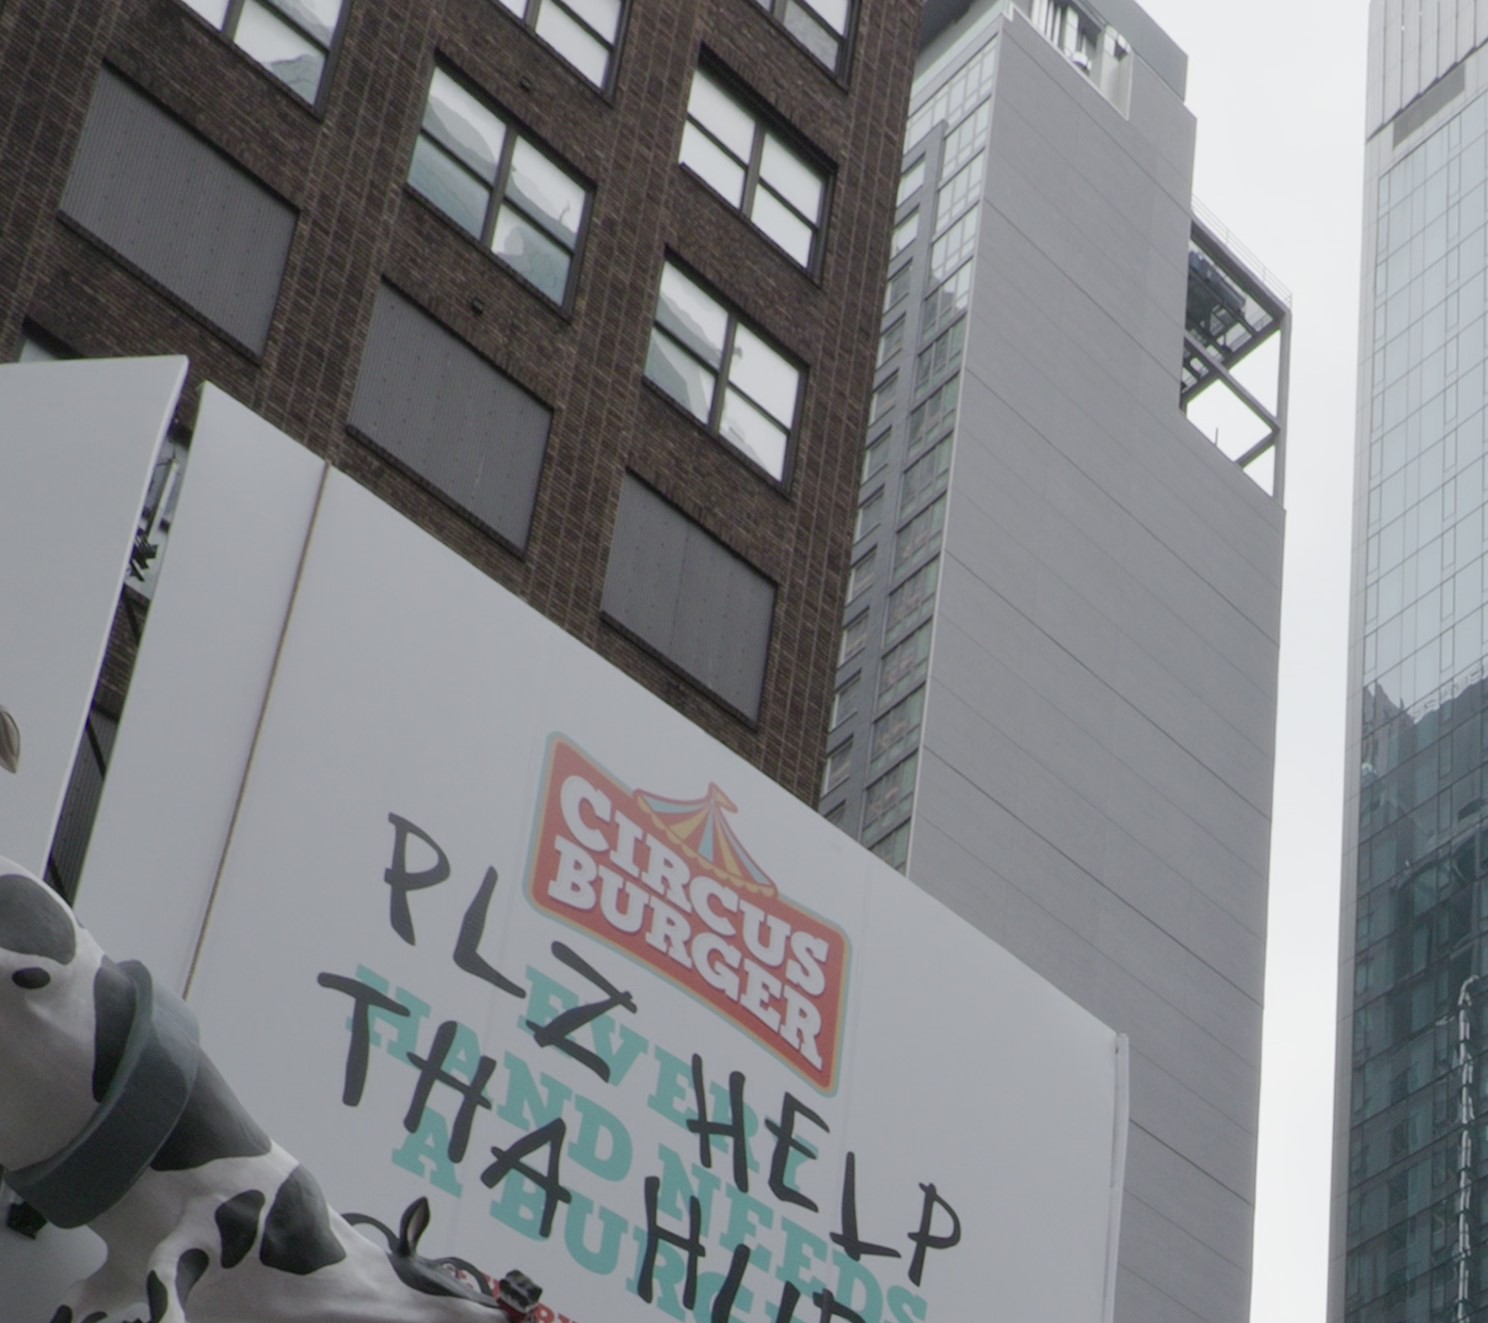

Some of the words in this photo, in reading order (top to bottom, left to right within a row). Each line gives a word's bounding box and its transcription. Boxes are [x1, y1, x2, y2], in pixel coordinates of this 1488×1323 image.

[546, 838, 826, 1074] BURGER
[559, 771, 830, 997] CIRCUS
[317, 970, 573, 1238] THA
[383, 811, 638, 1083] PLZ
[686, 1052, 962, 1287] HELP
[390, 1105, 464, 1199] A
[515, 963, 819, 1194] EVERY
